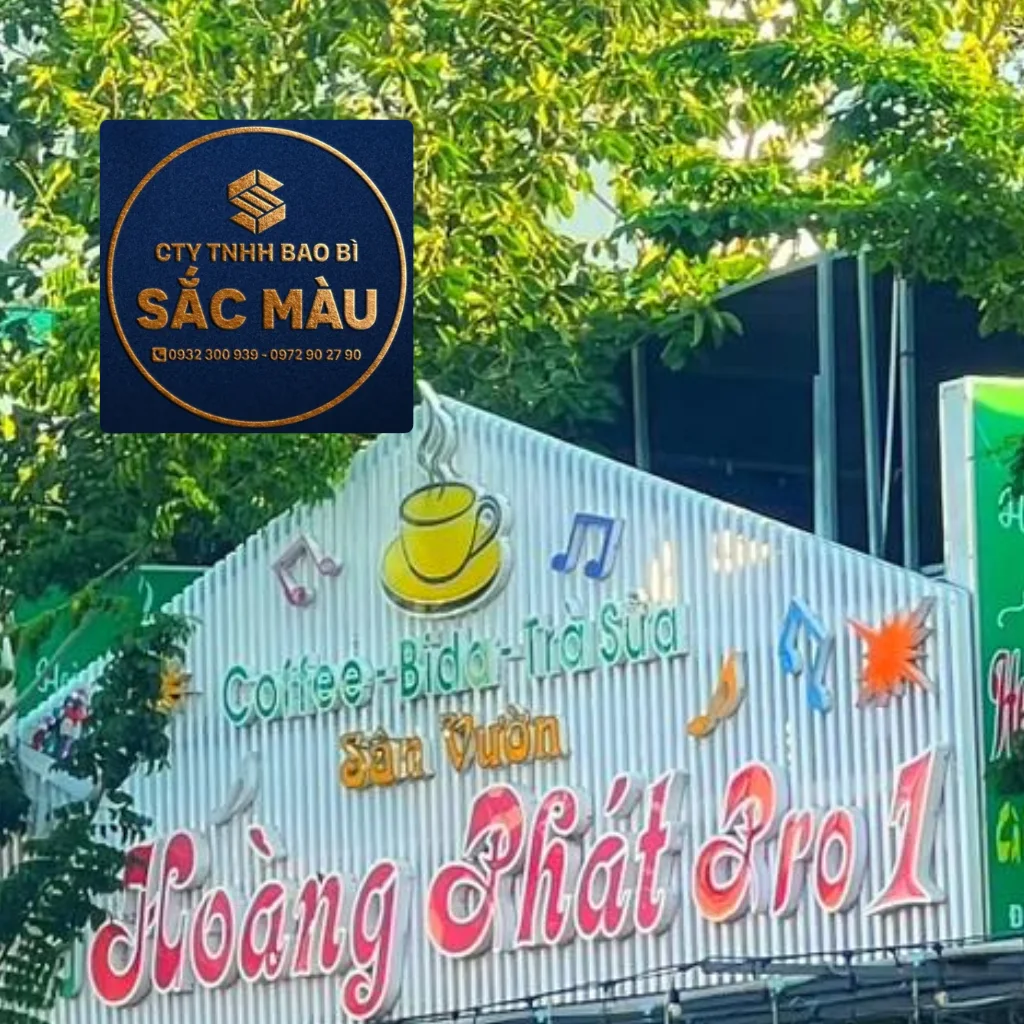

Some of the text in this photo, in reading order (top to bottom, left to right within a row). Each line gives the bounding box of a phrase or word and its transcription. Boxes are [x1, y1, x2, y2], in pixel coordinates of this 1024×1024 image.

[339, 704, 563, 789] Sân Vườn
[88, 748, 937, 1020] Hoàng Phát Pro 1
